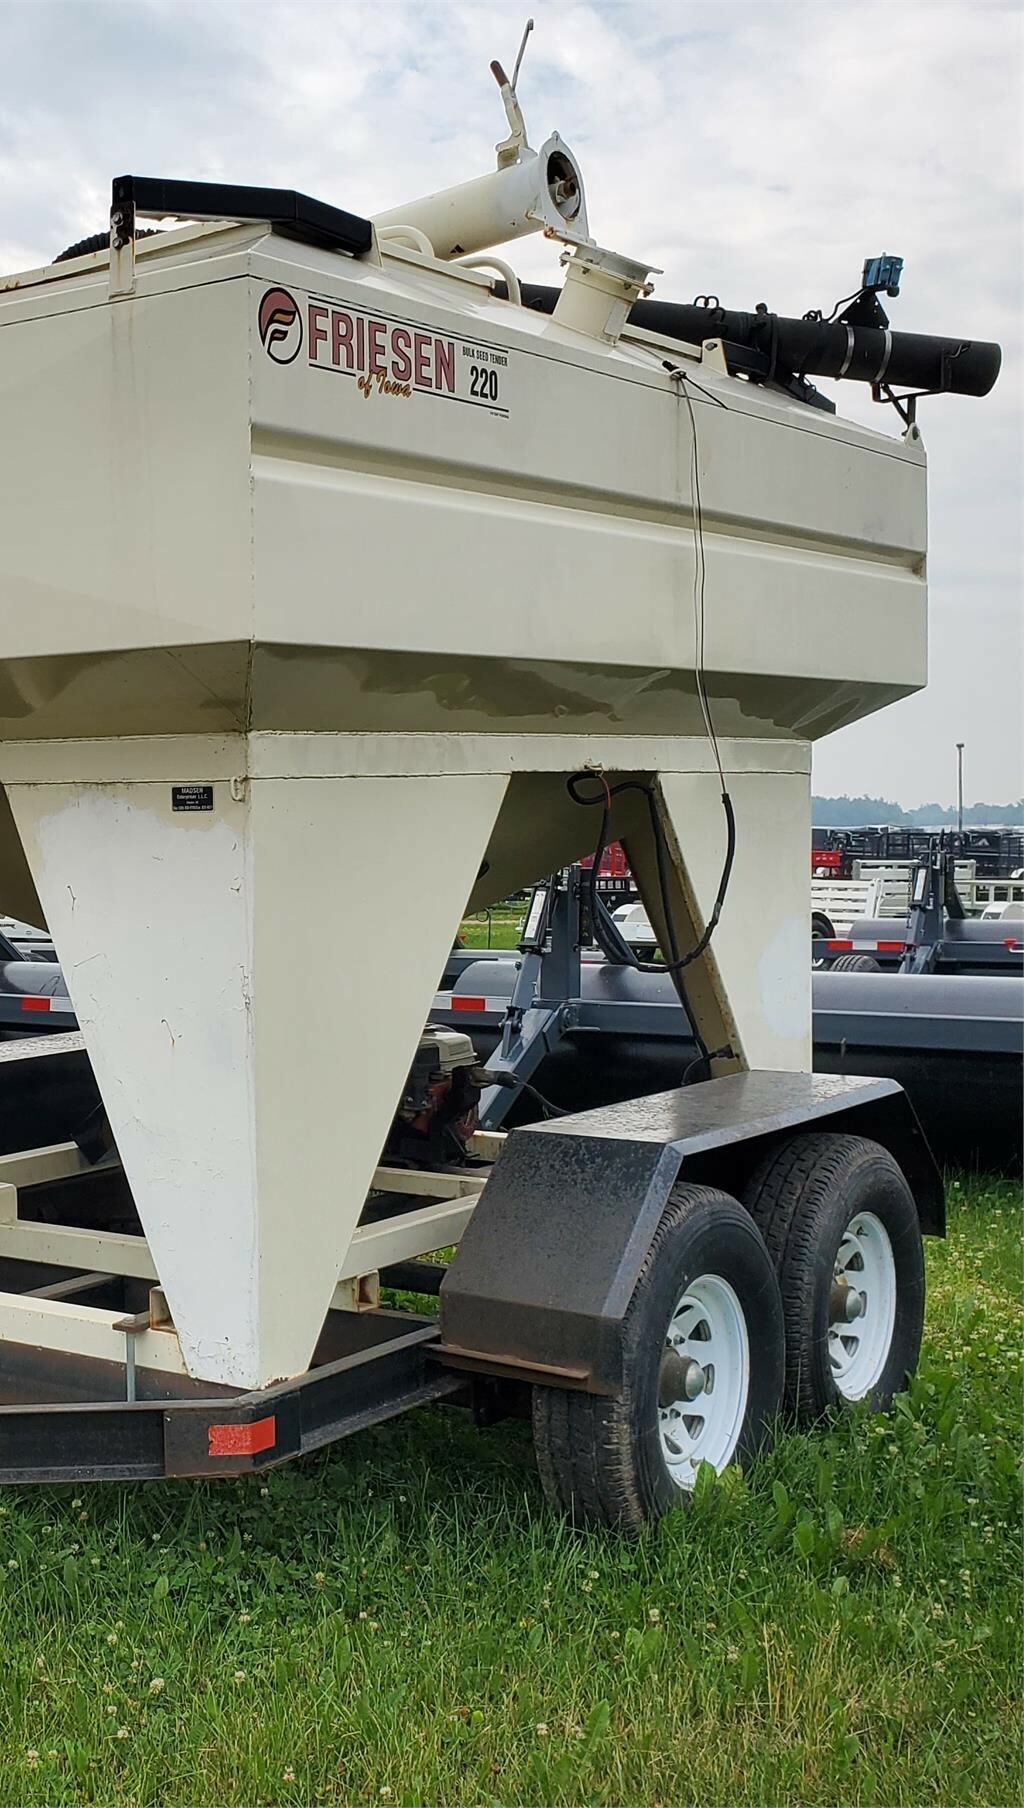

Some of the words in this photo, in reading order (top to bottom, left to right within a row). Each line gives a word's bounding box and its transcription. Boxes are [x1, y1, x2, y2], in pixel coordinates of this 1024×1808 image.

[308, 303, 456, 393] FRIESEN
[462, 346, 475, 358] BULK
[476, 350, 488, 362] SEED
[489, 353, 508, 367] TENDER
[357, 369, 372, 399] of
[470, 365, 498, 401] 220
